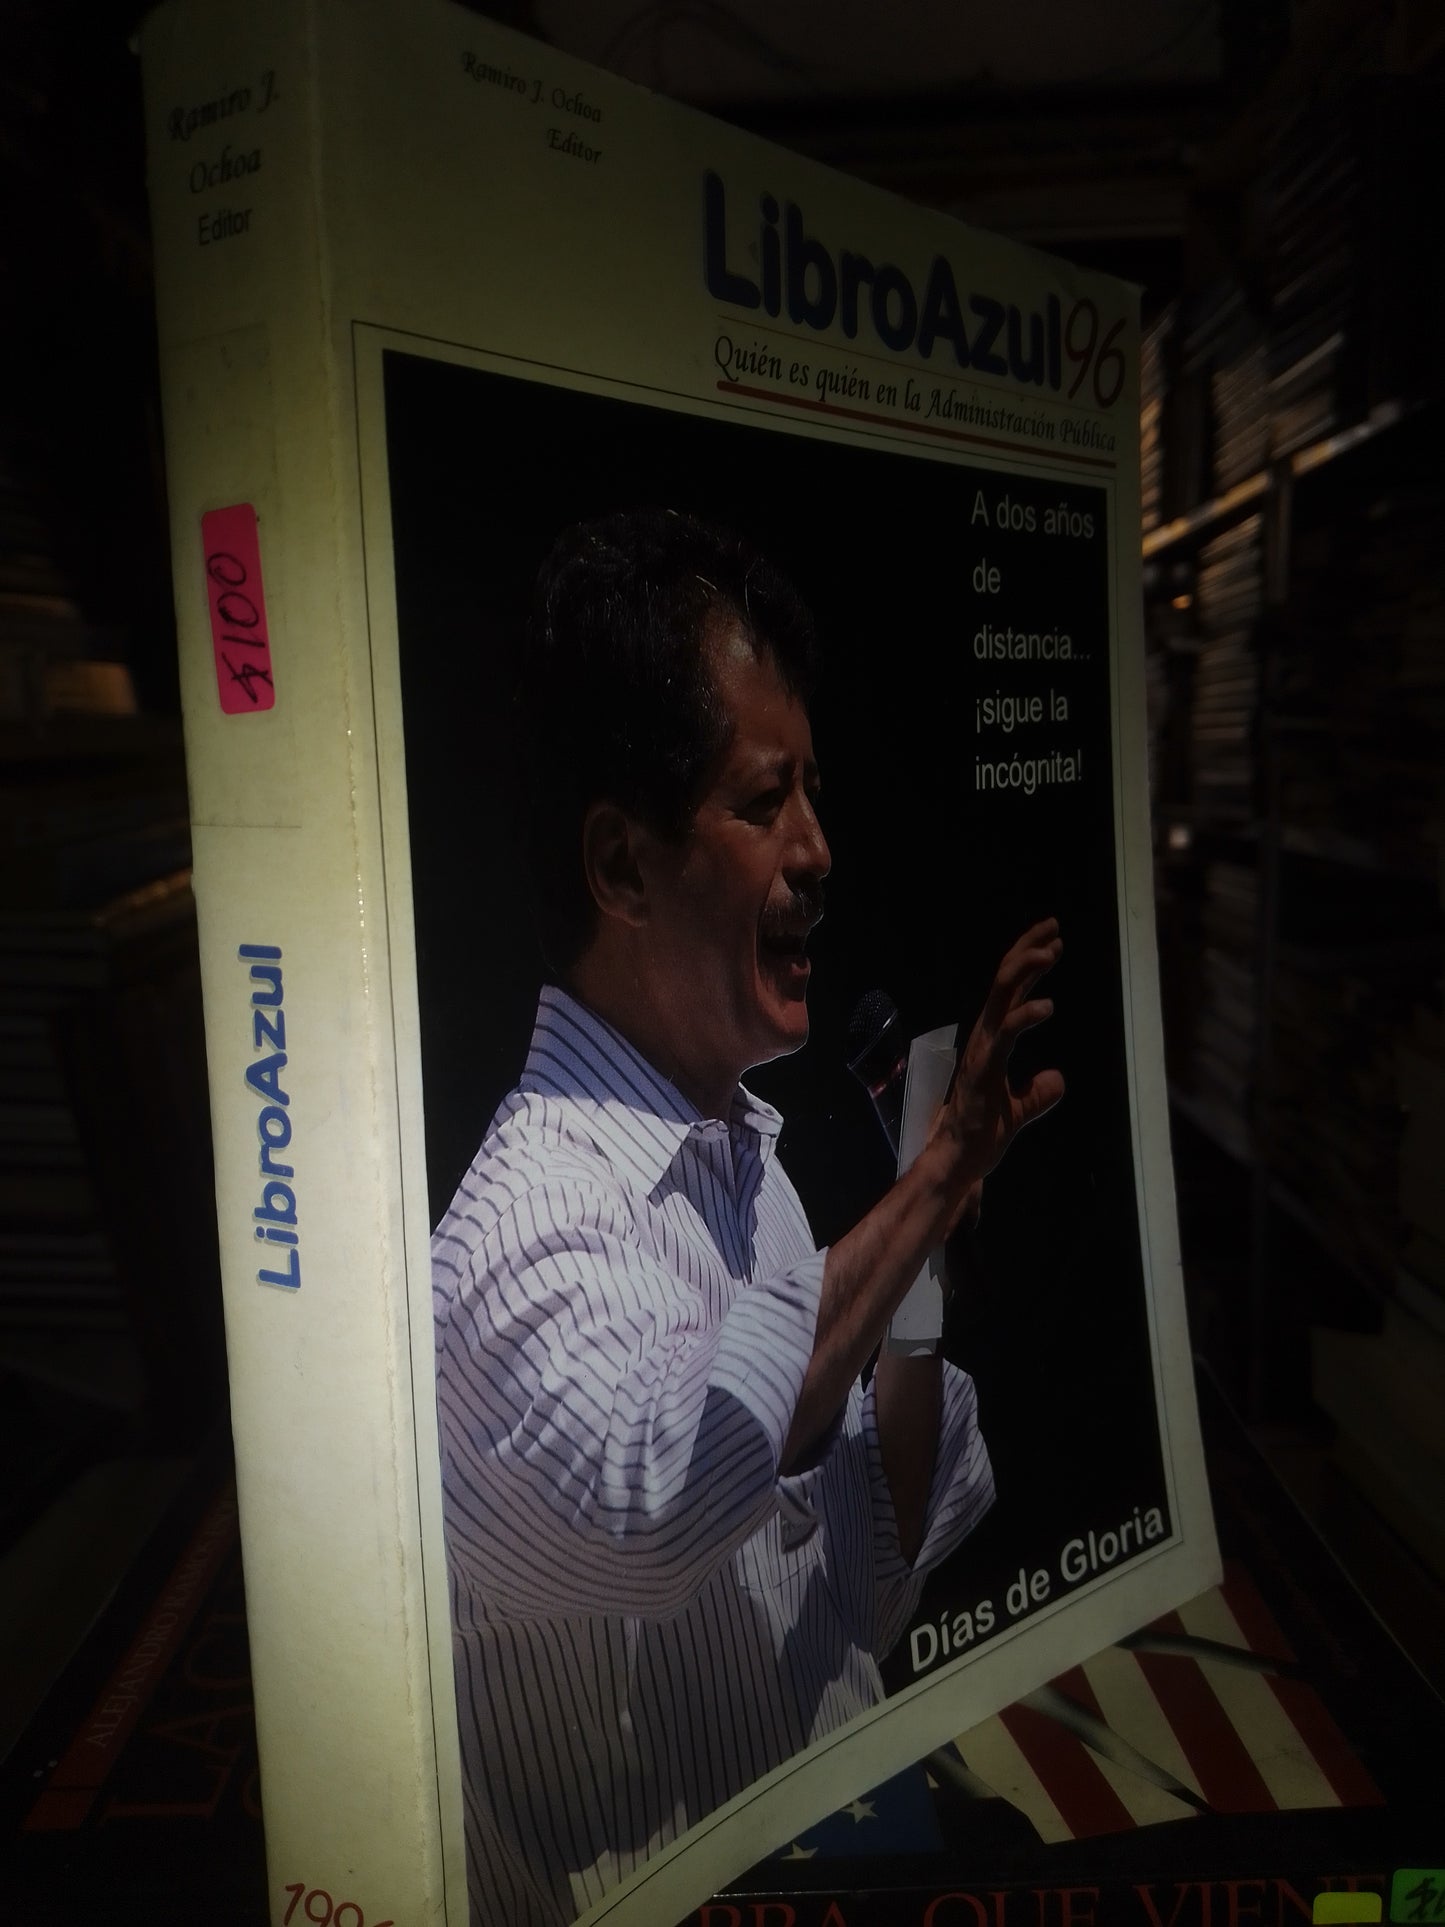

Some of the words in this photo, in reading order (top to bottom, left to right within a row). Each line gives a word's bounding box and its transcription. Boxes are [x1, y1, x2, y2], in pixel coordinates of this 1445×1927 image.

[461, 51, 527, 95] Ramiro
[551, 88, 602, 123] Ochoa
[167, 84, 251, 141] Ramiro
[190, 145, 261, 194] Ochoa
[547, 128, 602, 165] Editor
[199, 208, 252, 246] Editor
[714, 335, 782, 382] Quién
[789, 361, 809, 388] es
[815, 366, 870, 403] quién
[876, 380, 898, 407] en
[904, 379, 921, 412] la
[925, 389, 1056, 439] Administración
[1059, 417, 1117, 452] Pública
[970, 488, 991, 528] A
[996, 494, 1038, 533] dos
[1043, 502, 1095, 540] años
[972, 556, 1001, 595] de
[975, 690, 1044, 735] ¡sigue
[1050, 688, 1068, 722] la
[975, 747, 1083, 796] incógnita!
[239, 943, 302, 1290] LibroAzul
[909, 1600, 997, 1673] Días
[1005, 1568, 1051, 1616] de
[1059, 1506, 1166, 1583] Gloria
